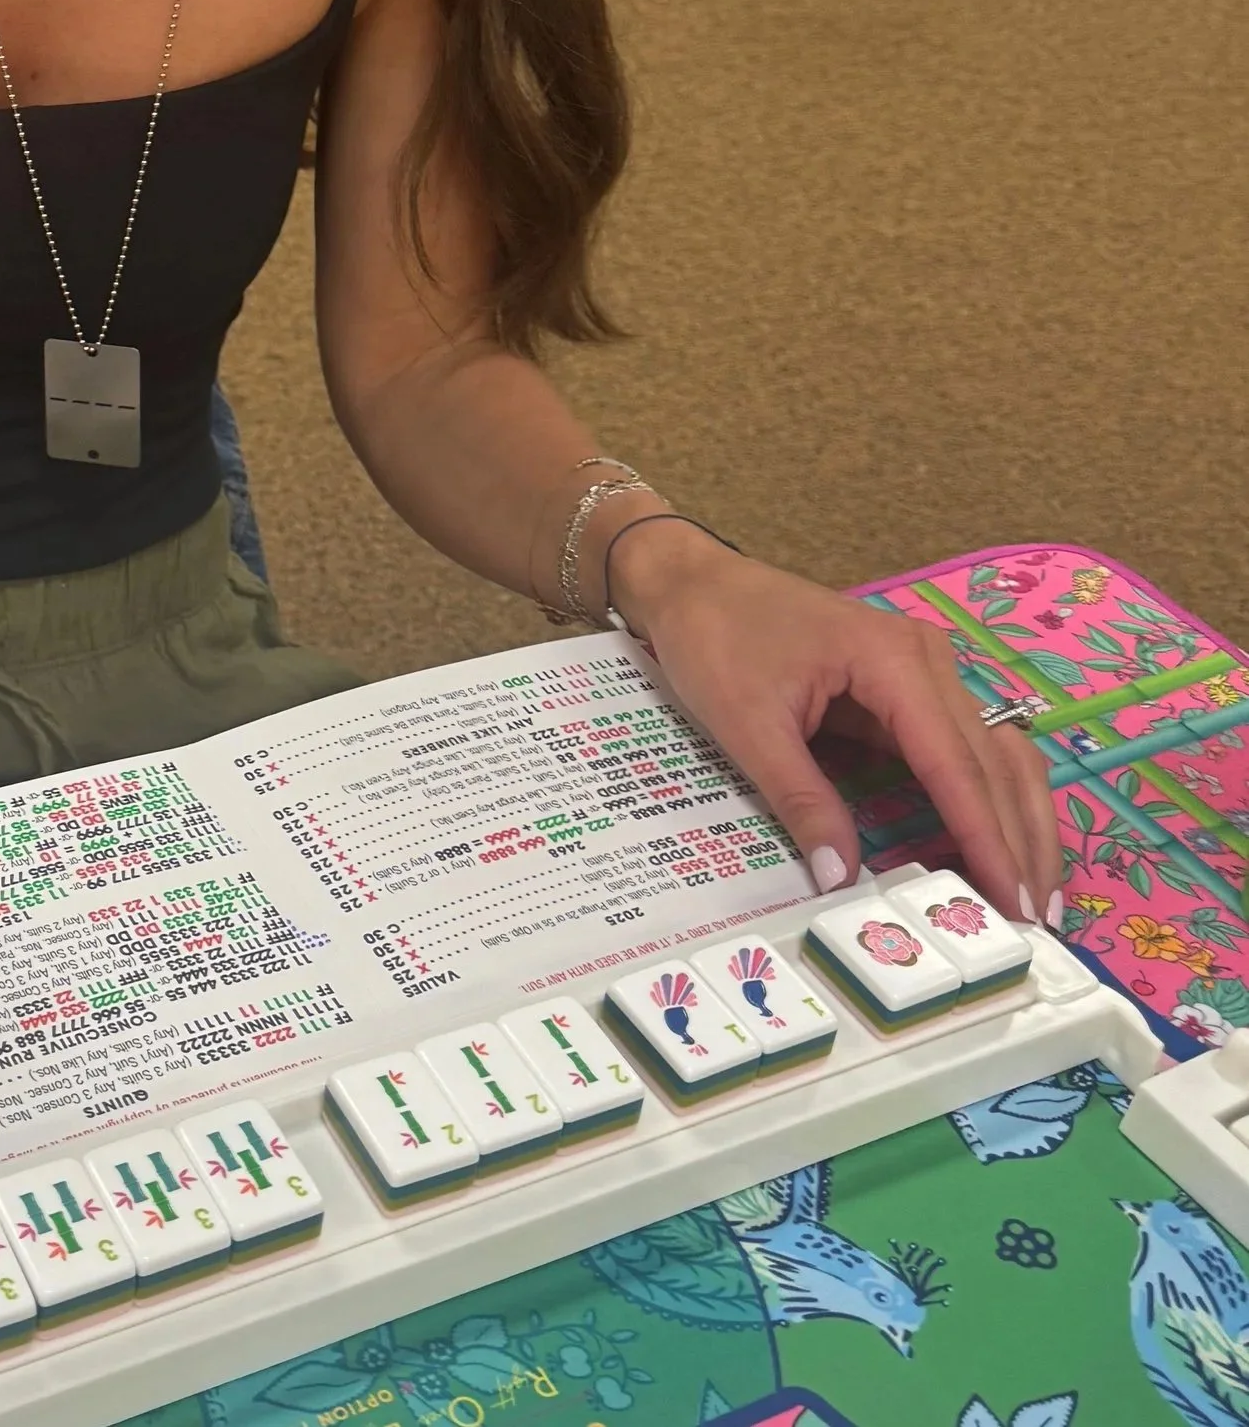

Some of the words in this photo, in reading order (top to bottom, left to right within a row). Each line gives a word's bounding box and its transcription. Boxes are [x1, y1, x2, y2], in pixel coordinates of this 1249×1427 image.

[470, 725, 503, 739] LIKE
[505, 717, 534, 731] ANY
[401, 734, 470, 758] NUMBERS
[547, 840, 586, 858] 2468
[746, 852, 786, 870] 2025
[713, 862, 746, 878] 222
[657, 878, 681, 891] (Any
[681, 871, 714, 887] 222
[649, 885, 660, 895] 3
[577, 901, 609, 915] Pungs
[605, 895, 628, 907] Like
[540, 917, 557, 927] 5s
[553, 914, 566, 923] or
[564, 910, 580, 920] 2s
[604, 906, 644, 926] 2025
[725, 912, 754, 926] USED
[530, 922, 544, 931] in
[686, 923, 715, 939] ZERO
[711, 919, 727, 931] AS
[480, 933, 511, 949] Suits)
[635, 941, 660, 955] MAY
[658, 937, 672, 948] IT
[593, 953, 624, 969] USED
[619, 948, 639, 960] BE
[392, 968, 415, 985] 25
[415, 962, 431, 975] X
[566, 962, 597, 978] WITH
[402, 970, 460, 998] VALUES
[544, 971, 568, 985] ANY
[292, 997, 343, 1020] 11111
[802, 997, 825, 1017] 1
[234, 1012, 289, 1036] NNNN
[299, 1017, 332, 1034] 111
[334, 1010, 353, 1025] FF
[38, 1011, 157, 1055] CONSECUTIVE
[176, 1028, 233, 1053] 22222
[251, 1026, 296, 1048] 2222
[723, 1023, 746, 1043] 1
[140, 1043, 174, 1063] (Any1
[196, 1040, 251, 1065] 33333
[153, 1065, 164, 1077] 3
[164, 1056, 192, 1072] (Any
[72, 1073, 84, 1085] 2
[85, 1065, 108, 1080] Any
[607, 1064, 629, 1084] 2
[81, 1088, 93, 1100] 3
[93, 1080, 116, 1095] Any
[83, 1089, 148, 1118] QUINTS
[525, 1092, 548, 1114] 2
[441, 1123, 463, 1146] 2
[287, 1175, 308, 1197] 3
[194, 1208, 214, 1230] 3
[98, 1239, 119, 1262] 3
[317, 1389, 395, 1427] OPTION
